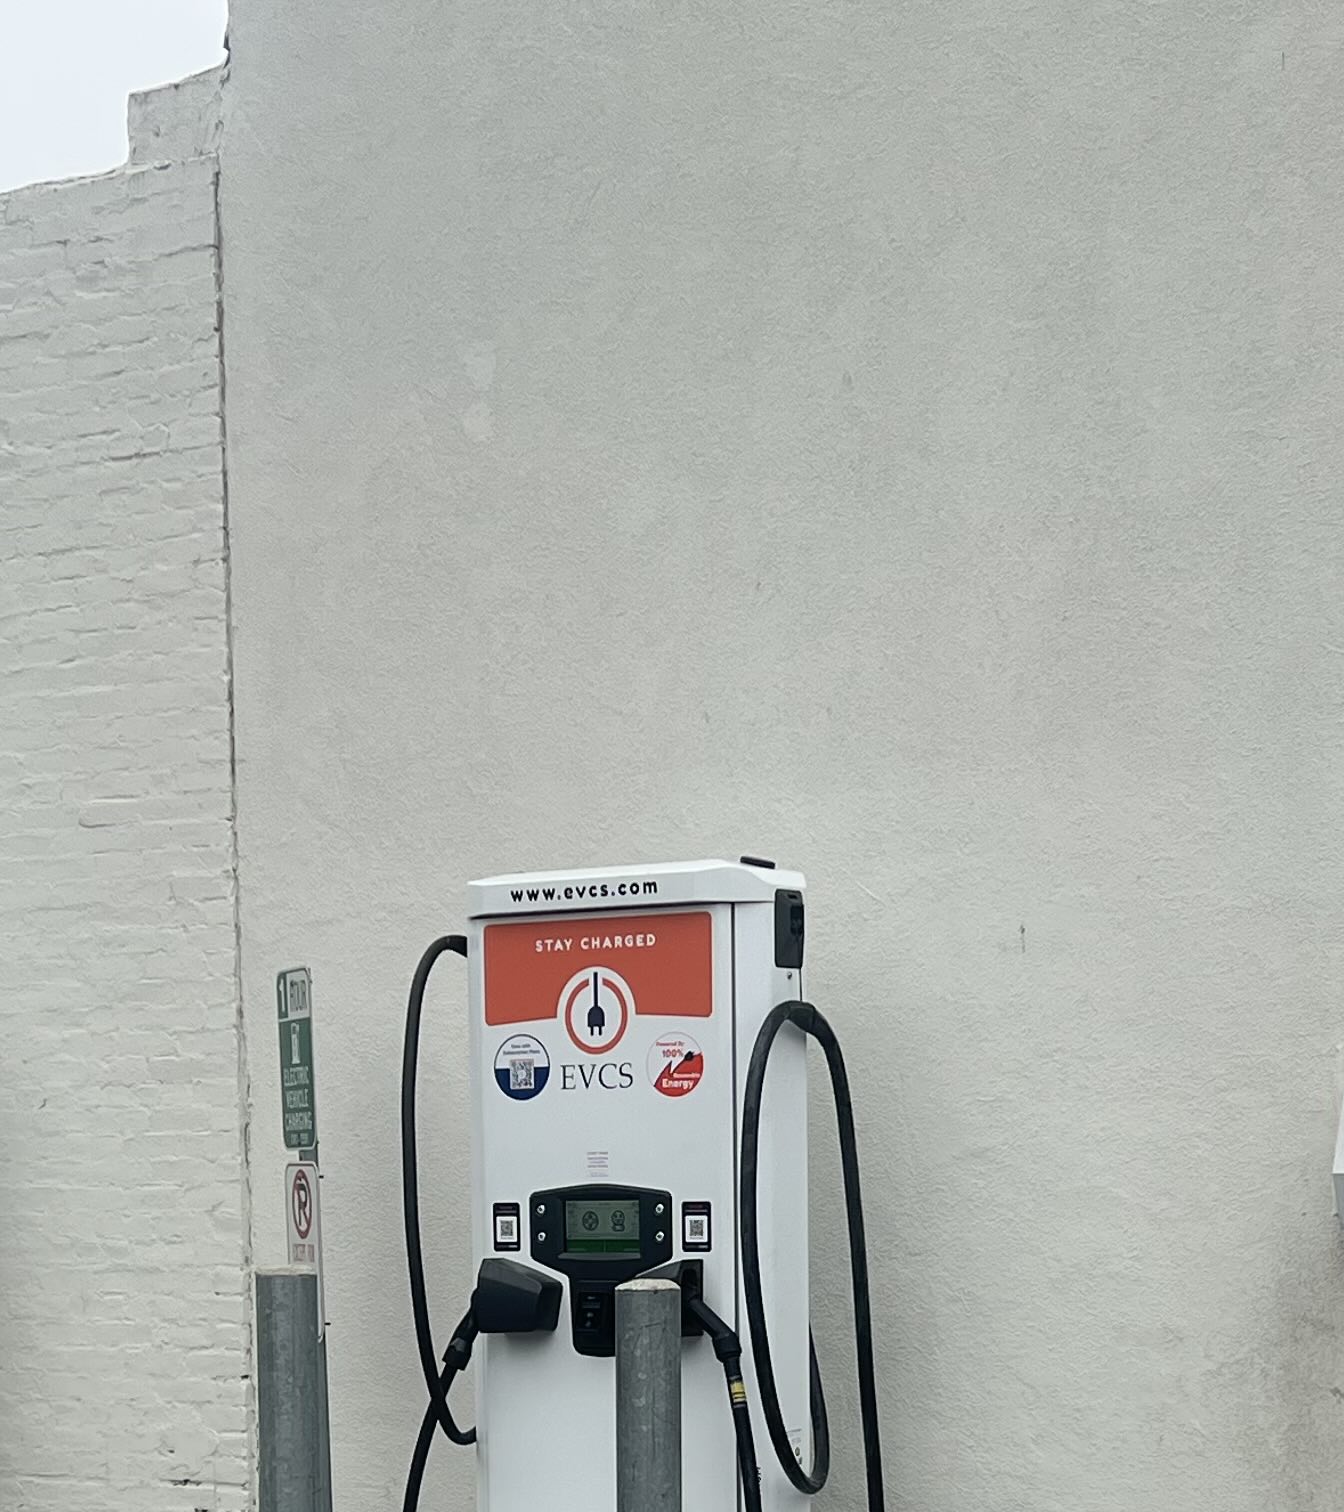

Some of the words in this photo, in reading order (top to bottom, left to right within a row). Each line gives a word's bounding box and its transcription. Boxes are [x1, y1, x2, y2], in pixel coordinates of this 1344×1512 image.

[510, 881, 658, 902] www.evcs.com
[535, 938, 573, 952] STAY
[580, 933, 656, 949] CHARGED
[559, 1062, 634, 1090] EVCS
[662, 1078, 695, 1090] Energy
